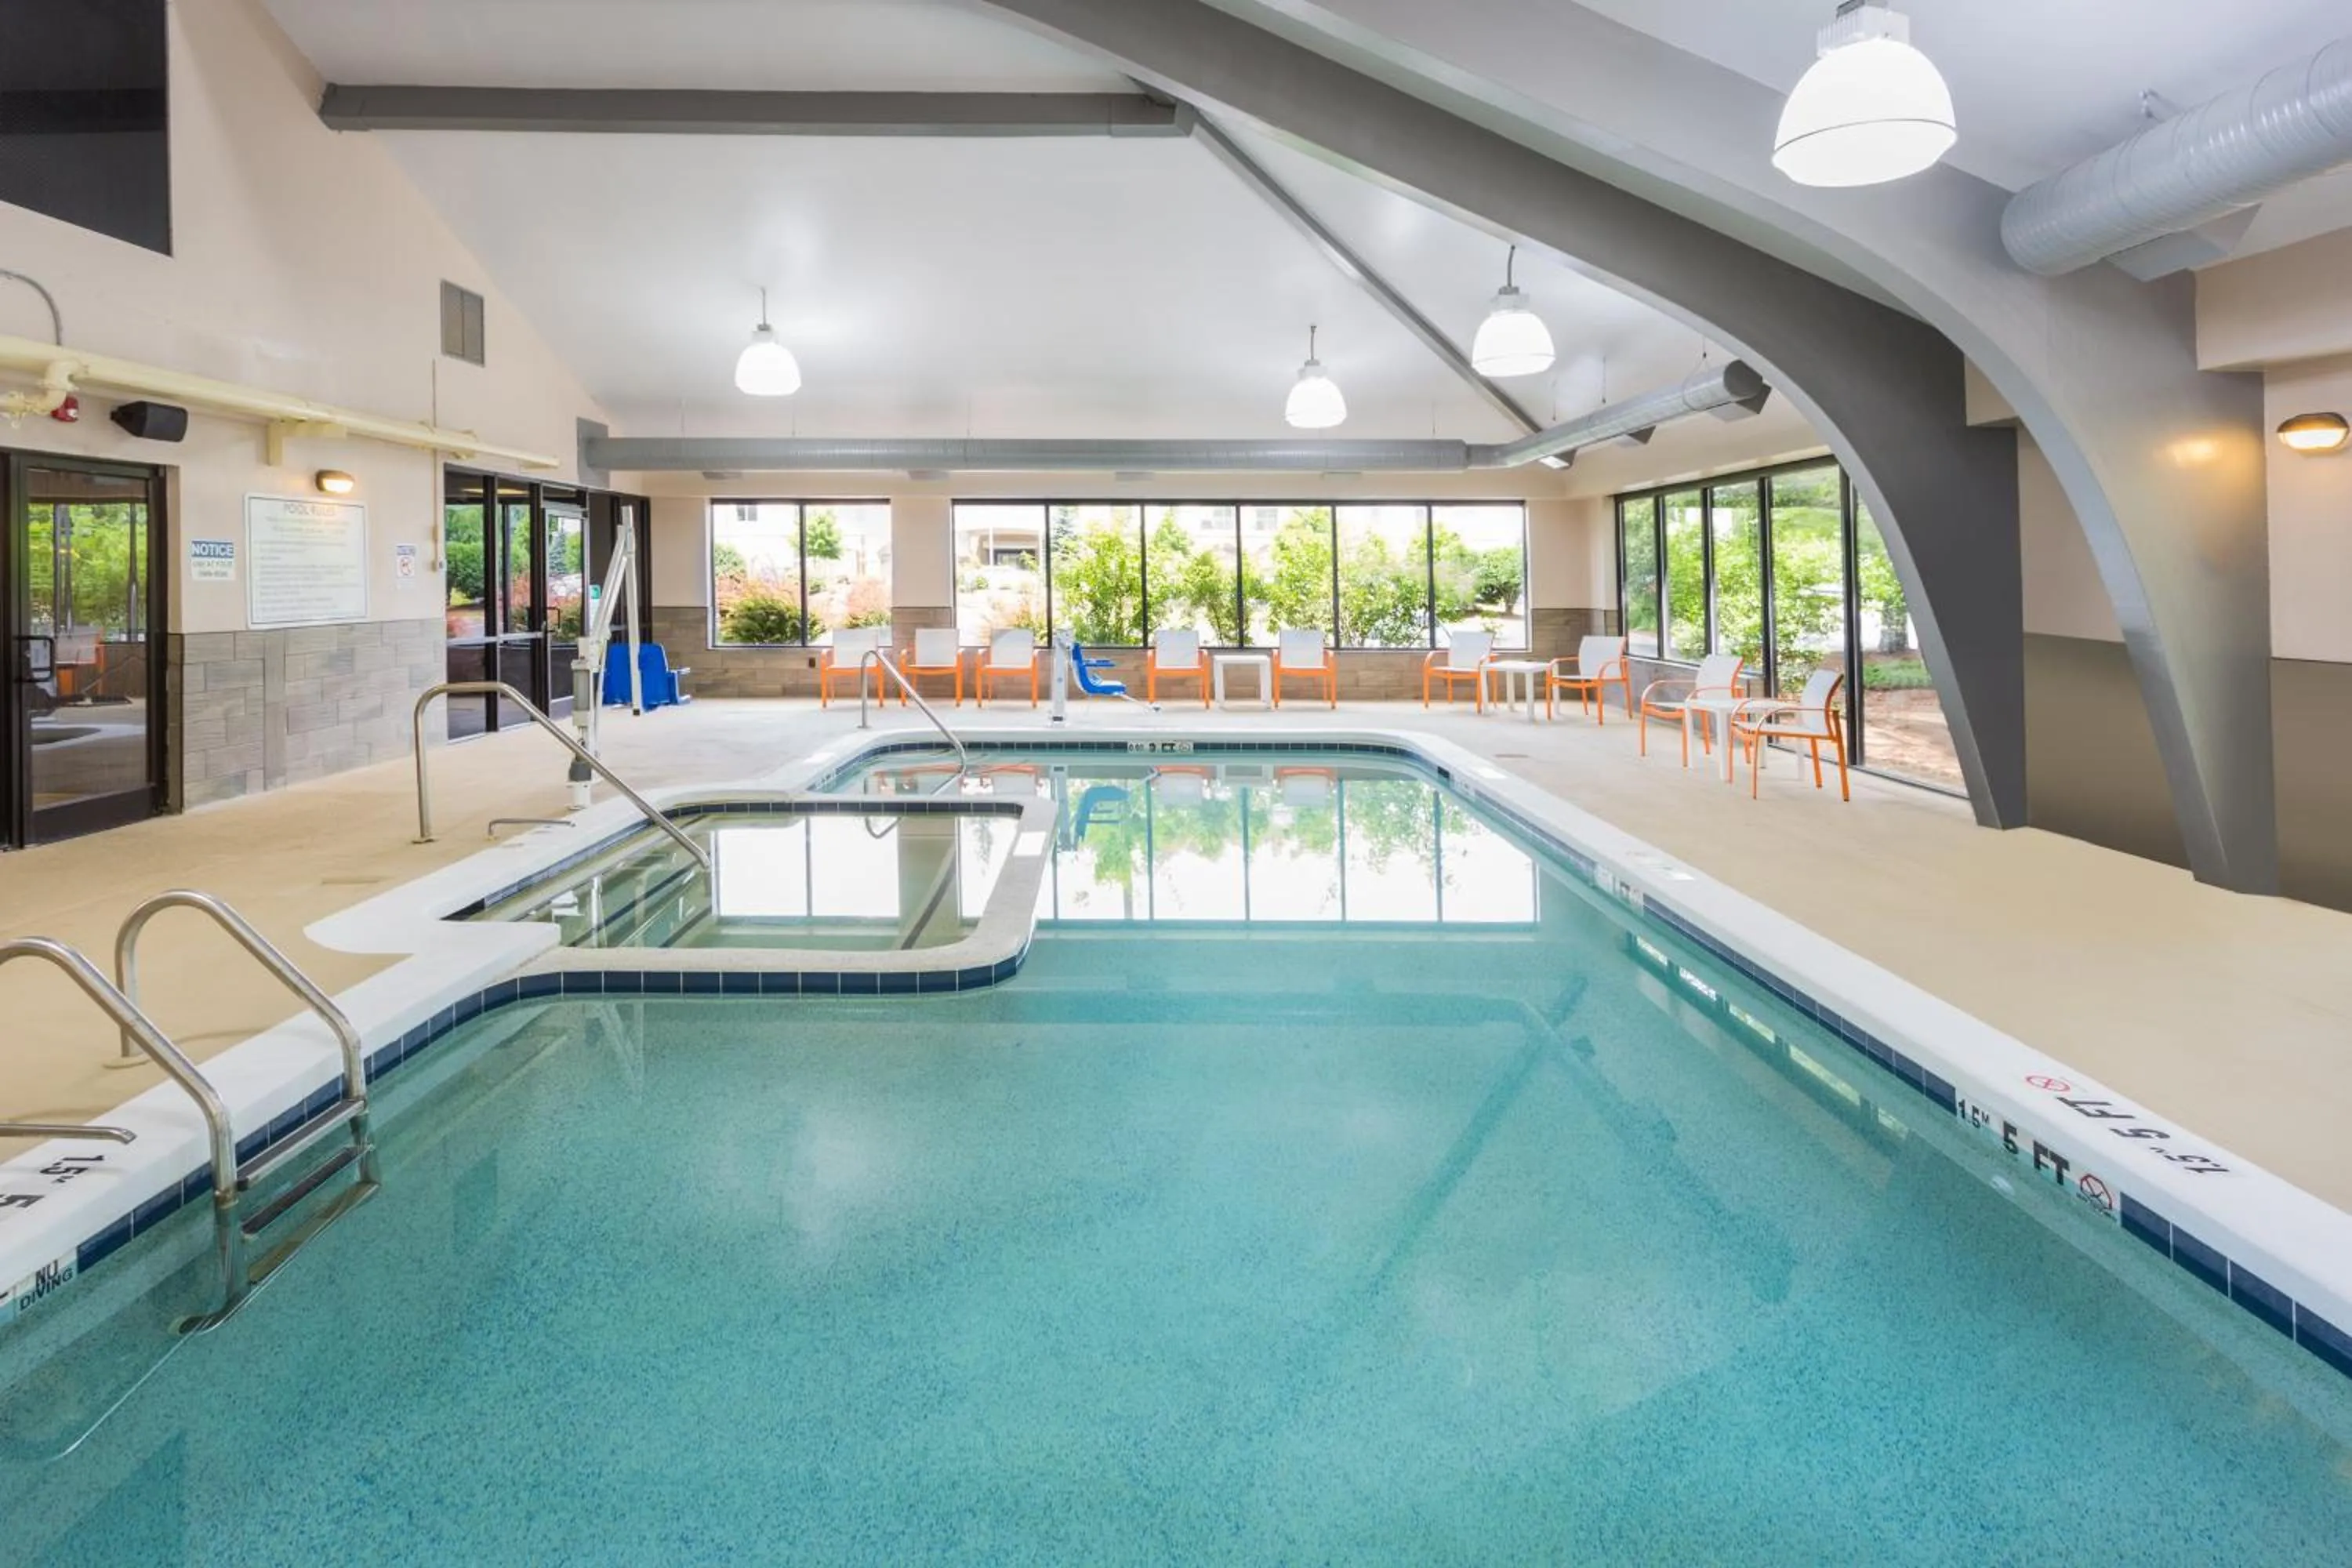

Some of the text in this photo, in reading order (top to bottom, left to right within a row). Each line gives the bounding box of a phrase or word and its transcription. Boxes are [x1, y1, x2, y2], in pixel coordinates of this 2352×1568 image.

[191, 543, 234, 557] NOTICE
[1162, 742, 1176, 752] FT
[2056, 1096, 2136, 1120] FT
[2109, 1127, 2171, 1139] 5
[2002, 1120, 2019, 1155] 5
[2033, 1139, 2071, 1185] FT
[20, 1268, 74, 1310] DIVING
